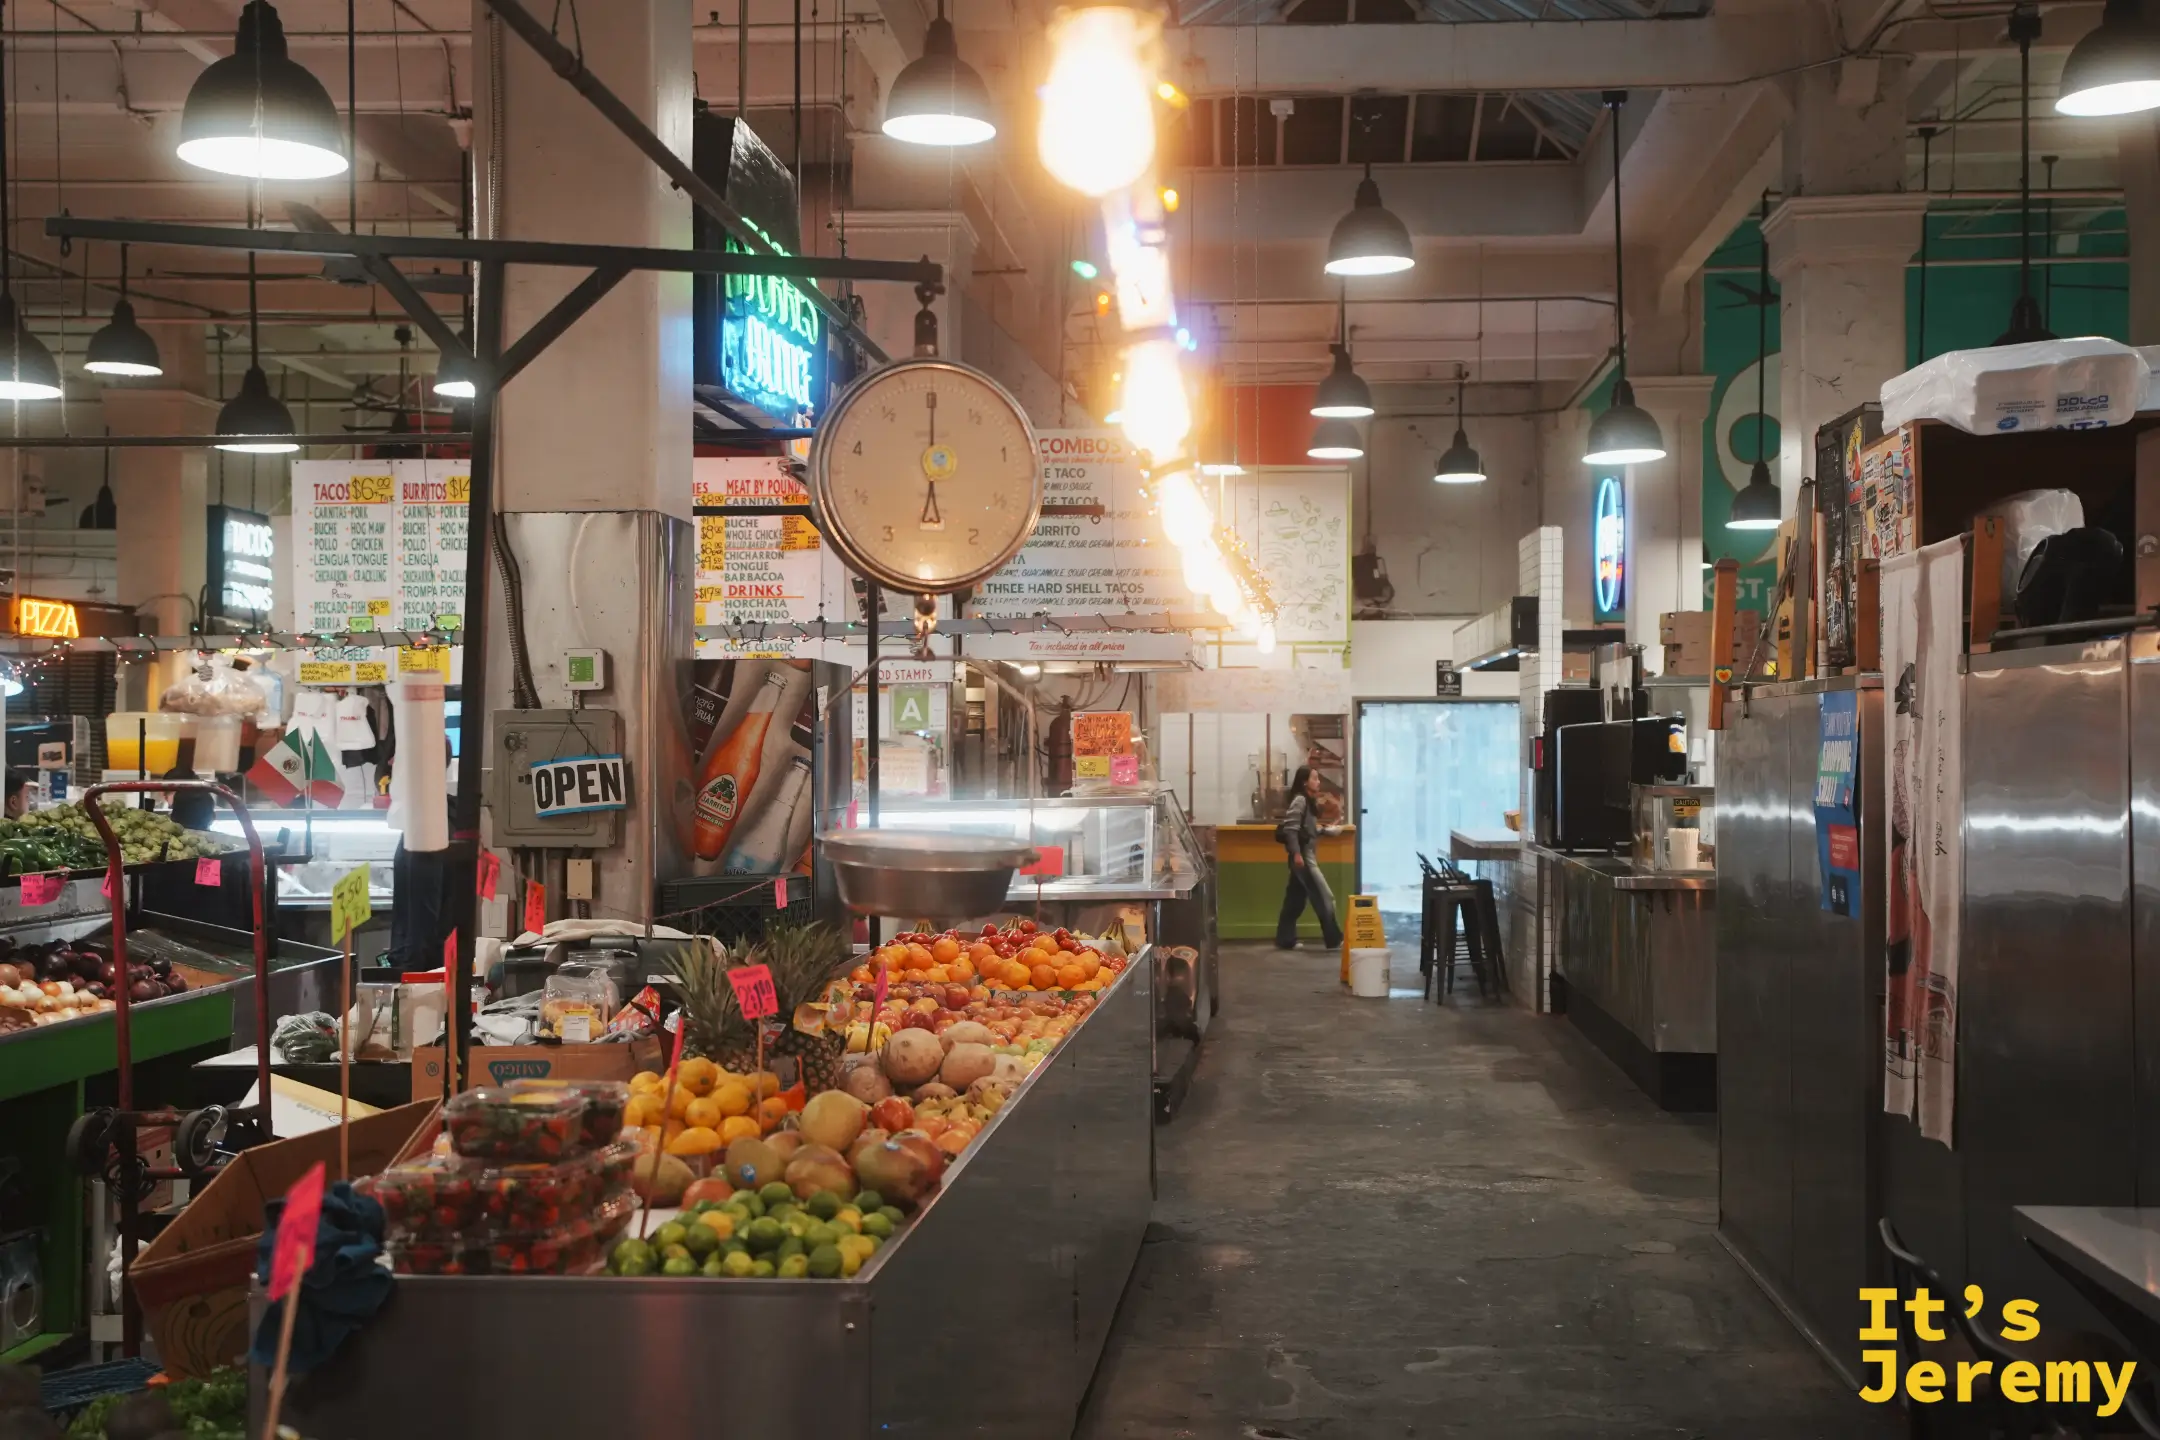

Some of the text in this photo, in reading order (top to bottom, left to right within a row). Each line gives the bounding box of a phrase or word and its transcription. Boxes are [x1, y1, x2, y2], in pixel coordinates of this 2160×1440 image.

[2057, 395, 2109, 407] DOLCO
[852, 440, 862, 456] 4
[1039, 438, 1121, 454] COMBOS
[1056, 468, 1085, 478] TACO
[313, 483, 350, 500] TACOS
[403, 483, 447, 500] BURRITOS
[726, 480, 751, 495] MEAT
[754, 480, 764, 494] BY
[724, 497, 780, 506] CARNITAS
[314, 507, 368, 519] CARNITAS PORK
[403, 507, 436, 518] CARNITAS
[440, 507, 458, 518] PORK
[314, 522, 386, 535] BUCHE HOG MAW
[403, 523, 427, 534] BUCHE
[440, 523, 457, 534] HOG
[725, 519, 759, 528] BUCHE
[725, 530, 753, 540] WHOLE
[882, 525, 894, 542] 3
[968, 528, 979, 545] 2
[314, 539, 384, 550] POLLO CHICKEN
[403, 539, 427, 550] POLLO
[314, 554, 388, 565] LENGUA TONGUE
[403, 554, 440, 565] LENGUA
[724, 551, 785, 560] CHICHARRON
[726, 562, 769, 571] TONGUE
[724, 573, 784, 581] BARBACOA
[402, 586, 465, 597] TROMPA PORK
[728, 585, 783, 596] DRINKS
[986, 583, 1024, 593] THREE
[1028, 583, 1063, 593] HARD
[1066, 582, 1101, 593] SHELL
[1106, 582, 1144, 593] TACOS
[314, 602, 366, 613] PESCADO FISH
[403, 602, 457, 614] PESCADO FISH
[724, 599, 788, 608] HORCHATA
[20, 599, 80, 638] PIZZA
[724, 610, 790, 619] TAMARINDO
[314, 618, 341, 629] BIRRIA
[724, 643, 794, 652] COKE CLASSIC
[1029, 640, 1125, 652] Tax included in all prices
[315, 649, 370, 661] ASADA BEEF
[895, 670, 933, 680] STAMPS
[900, 697, 922, 721] A
[535, 763, 622, 809] OPEN
[702, 796, 730, 814] JARRITOS
[494, 1063, 545, 1076] AMIGO
